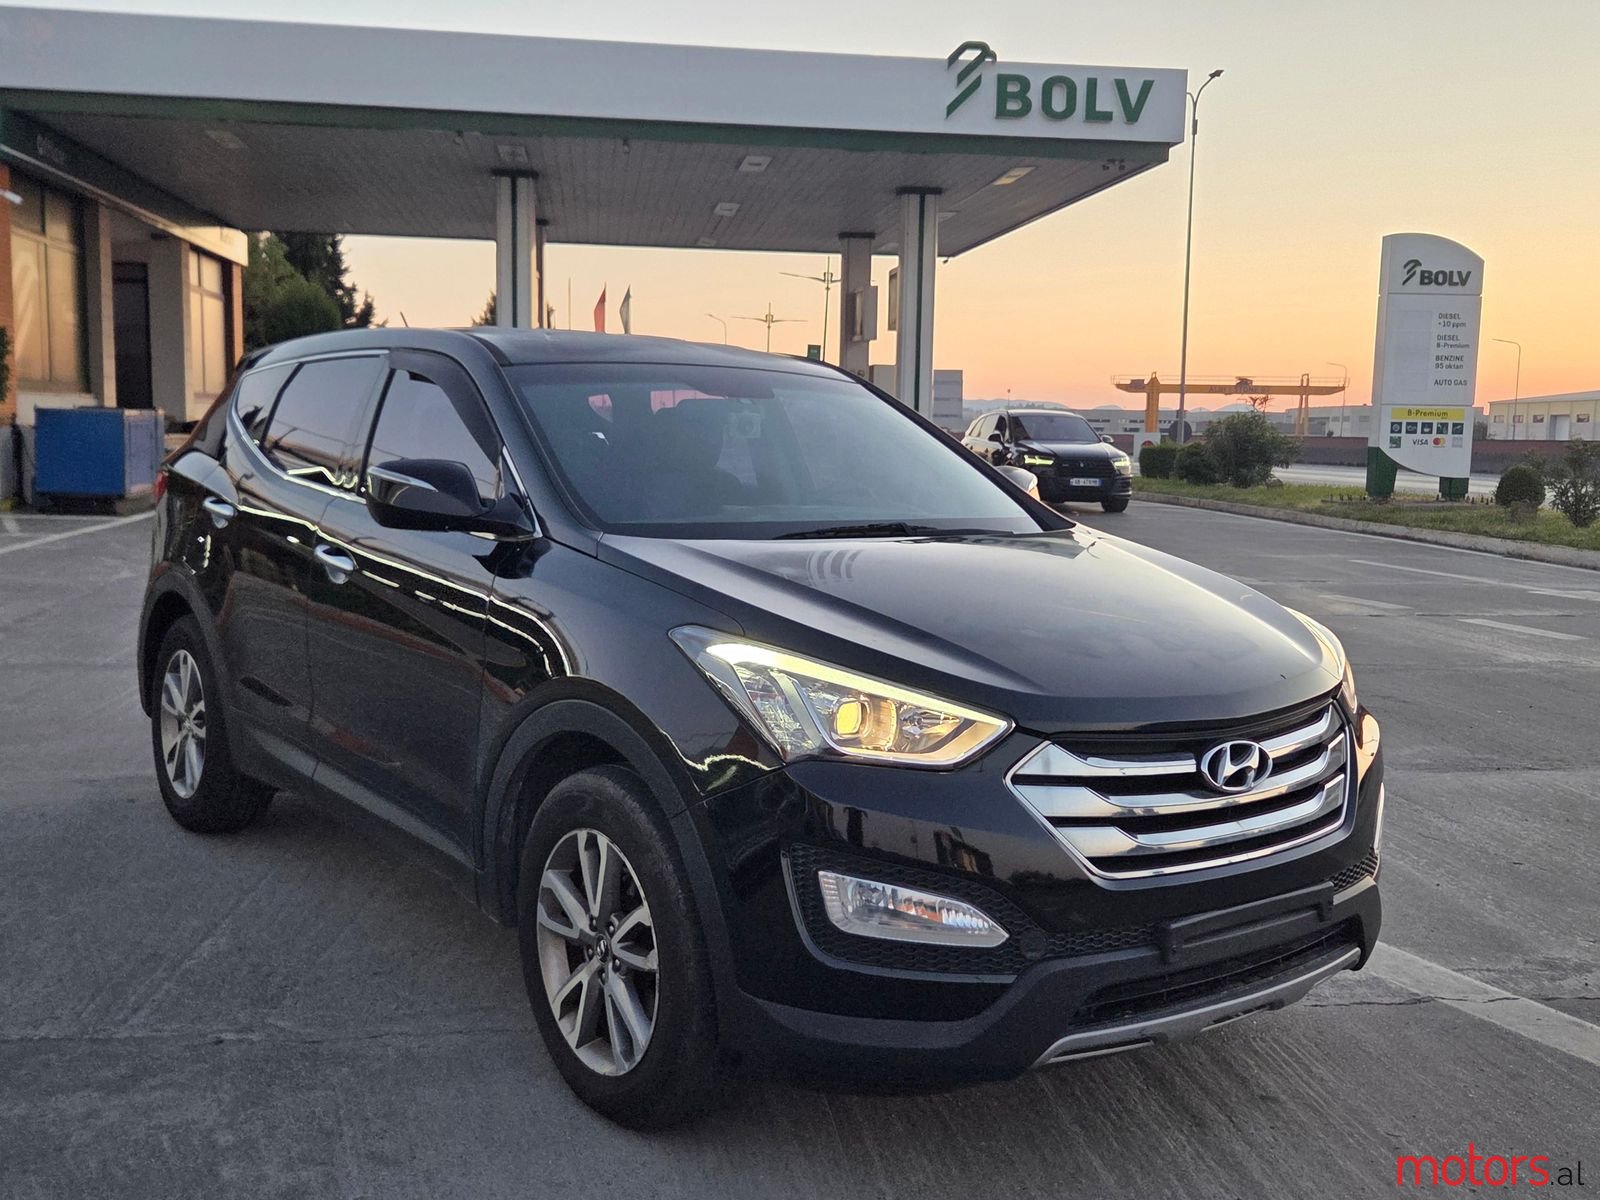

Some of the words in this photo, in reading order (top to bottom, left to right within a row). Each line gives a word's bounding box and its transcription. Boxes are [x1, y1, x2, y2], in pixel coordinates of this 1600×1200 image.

[995, 73, 1155, 124] BOLV
[1419, 269, 1472, 287] BOLV
[1438, 312, 1462, 320] DIESEL
[1445, 362, 1464, 370] oktan
[1407, 408, 1449, 417] B-Premium
[1412, 438, 1429, 446] VISA
